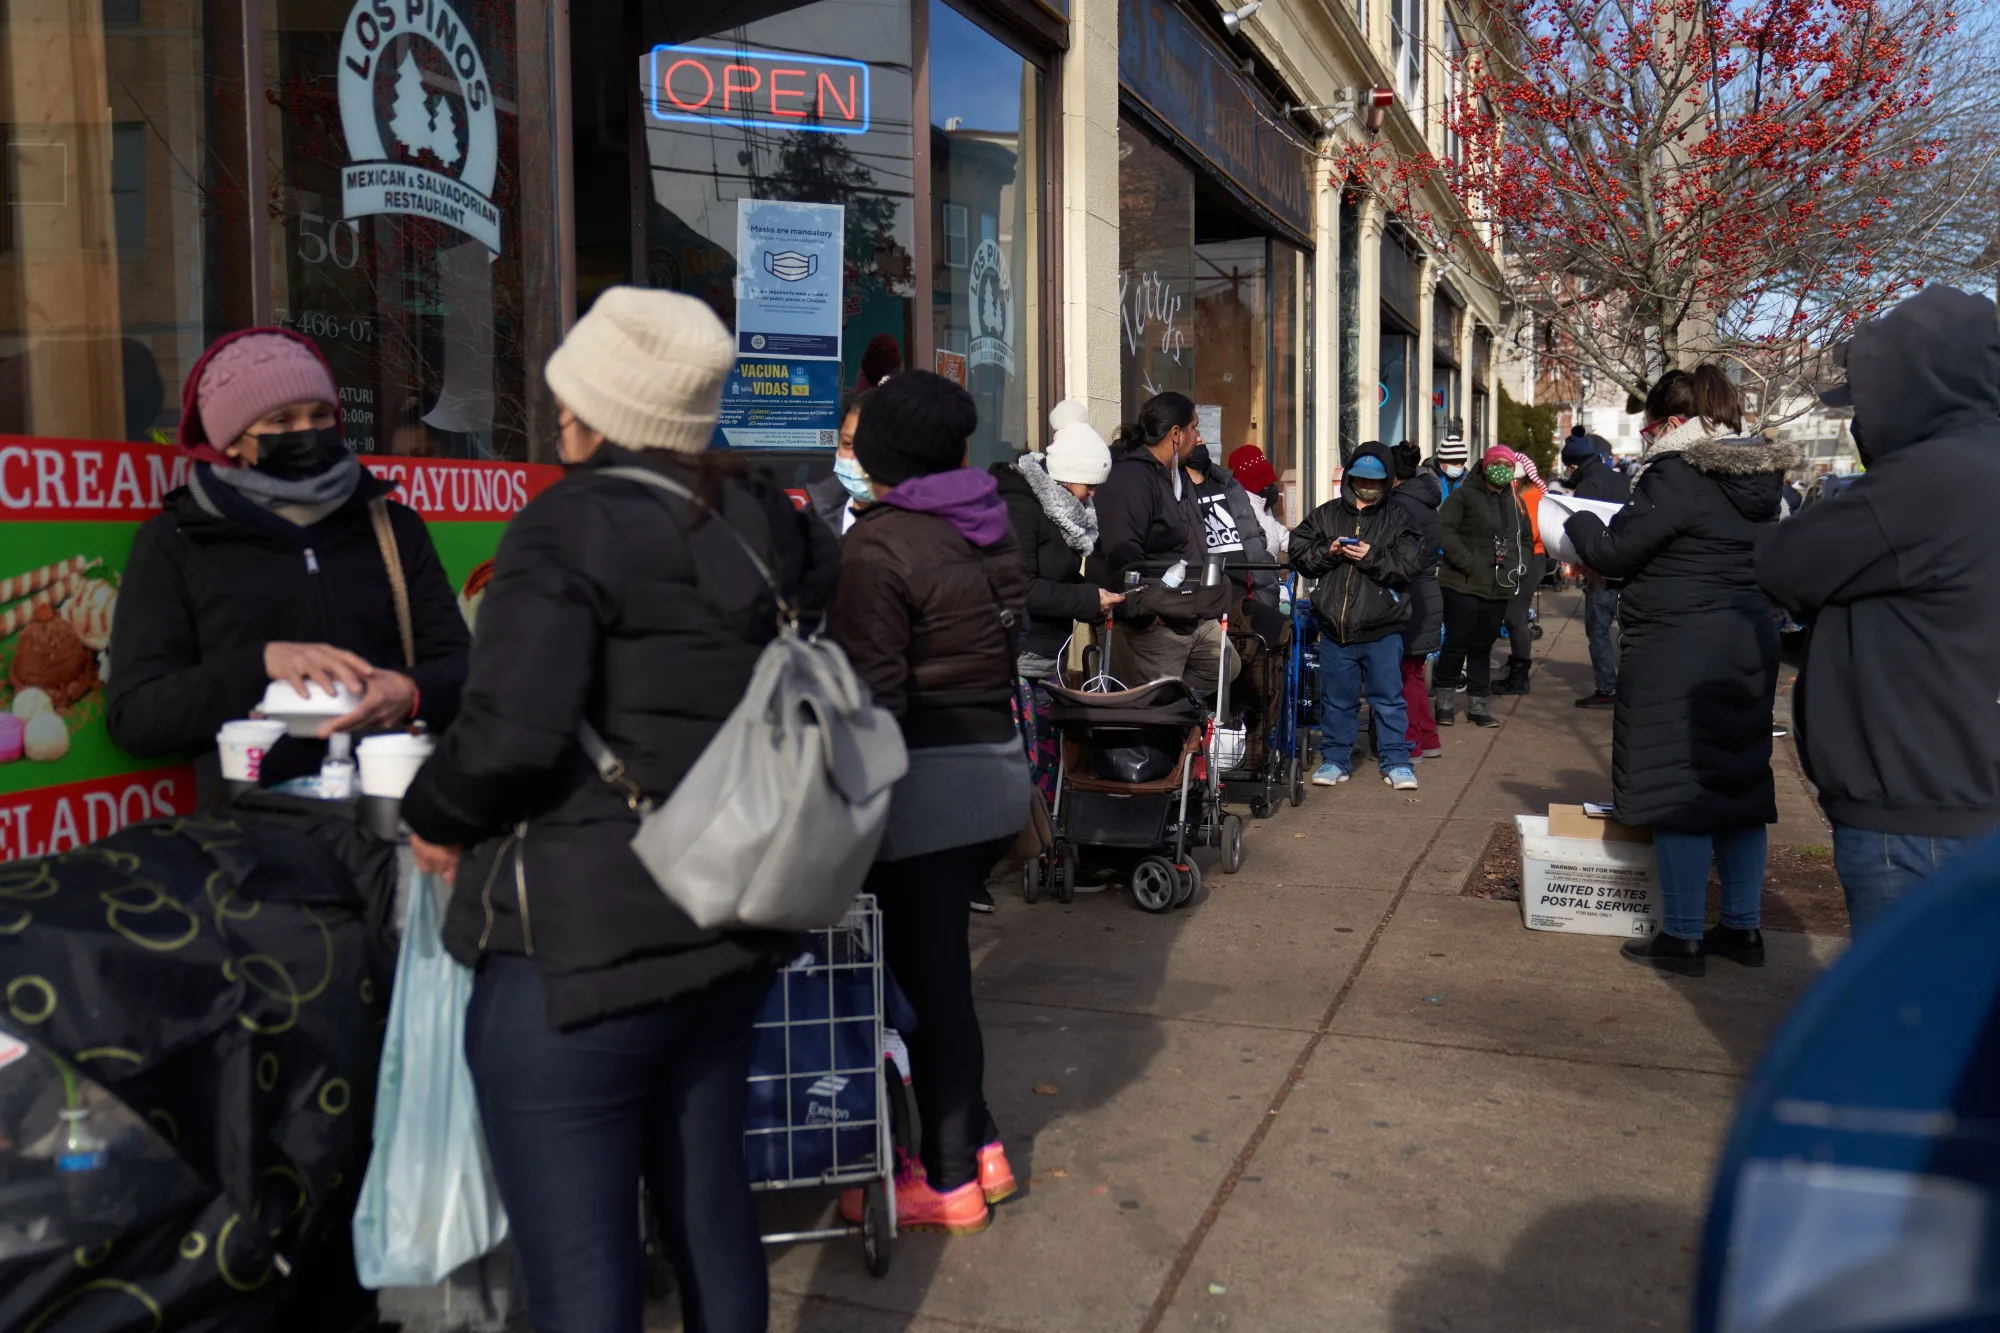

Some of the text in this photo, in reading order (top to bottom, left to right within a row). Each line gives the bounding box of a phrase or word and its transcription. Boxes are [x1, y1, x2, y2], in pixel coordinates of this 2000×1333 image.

[345, 0, 488, 111] LOS PINOS
[664, 59, 855, 120] OPEN
[347, 170, 498, 226] MEXICAN & SALVADORIAN
[384, 191, 466, 226] RESTAURANT
[750, 225, 833, 239] Masks are mandatory
[970, 249, 986, 297] LOS
[740, 363, 789, 379] VACUNA
[753, 381, 789, 396] VIDAS
[0, 445, 189, 510] CREAM
[1550, 863, 1578, 872] WARNING
[1582, 865, 1594, 873] NOT
[1595, 866, 1608, 874] FOR
[1608, 867, 1633, 876] PRIVATE
[1546, 882, 1648, 900] UNITED STATES
[1540, 895, 1652, 914] POSTAL SERVICE
[808, 1100, 850, 1120] Exeon
